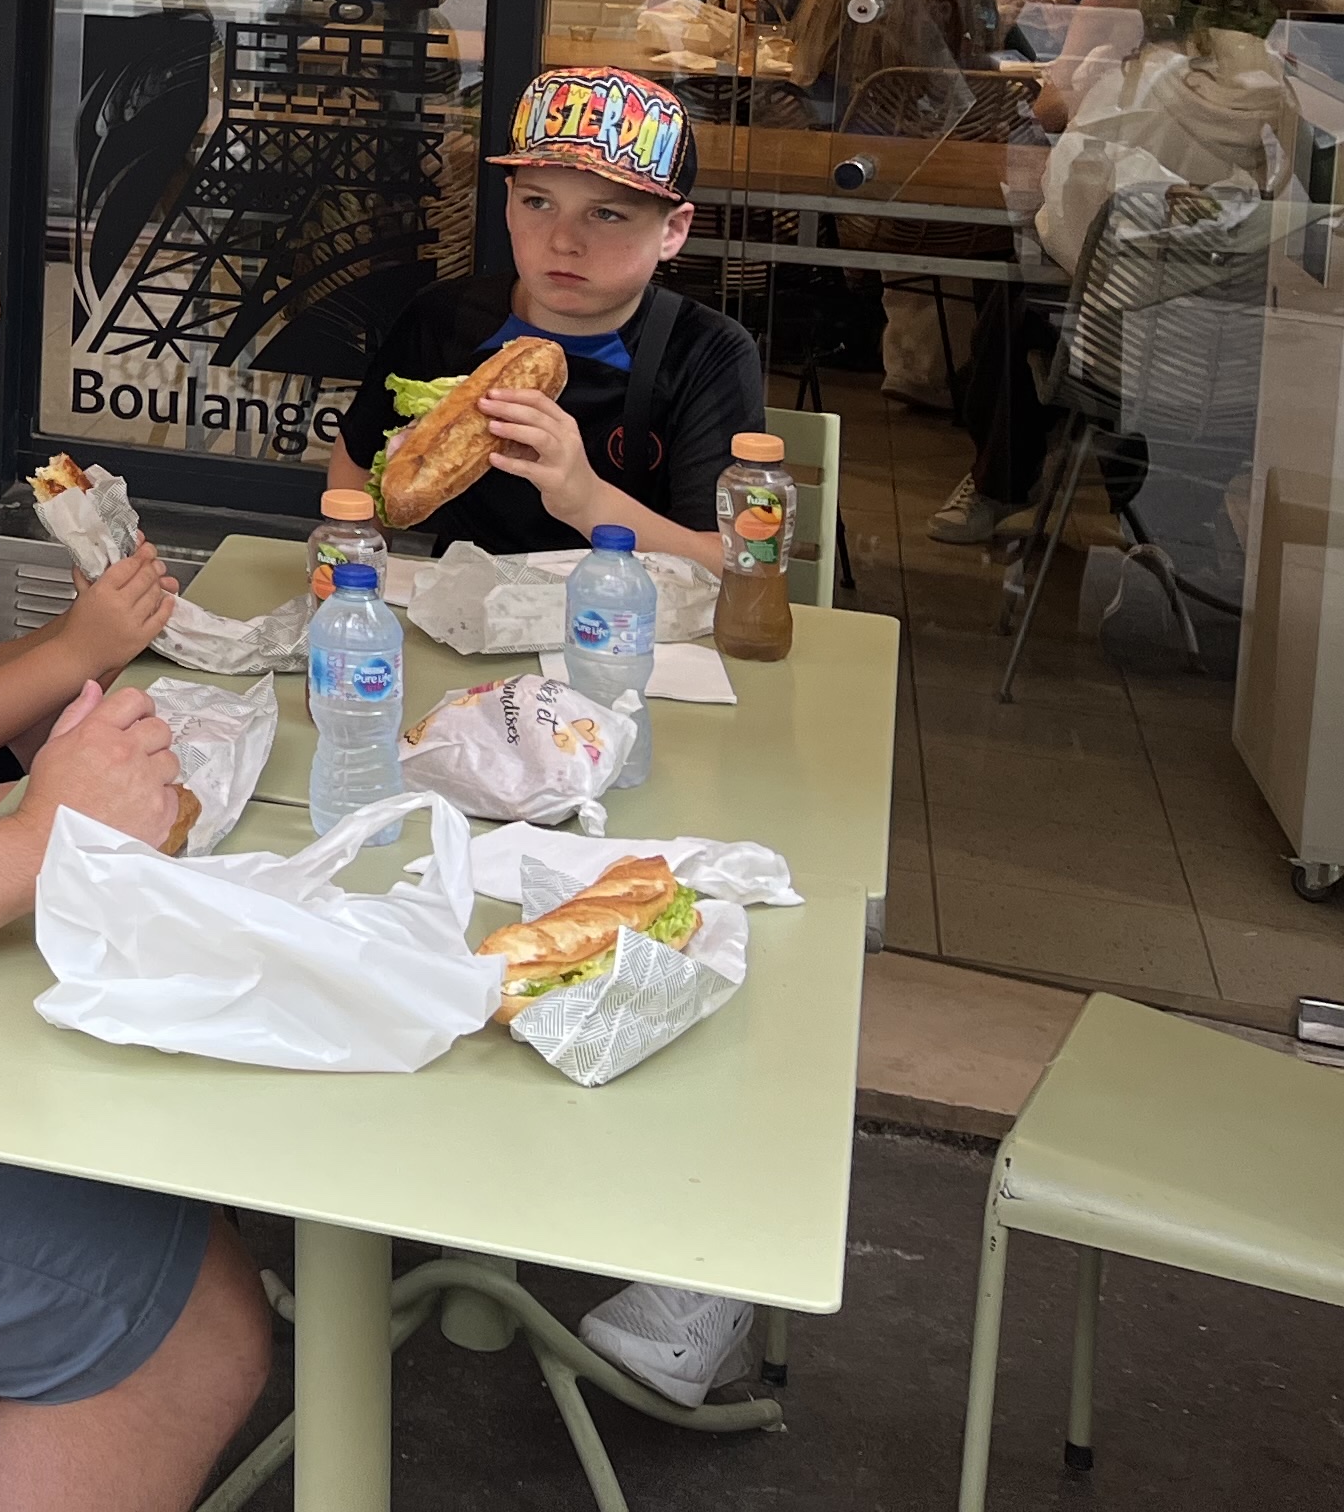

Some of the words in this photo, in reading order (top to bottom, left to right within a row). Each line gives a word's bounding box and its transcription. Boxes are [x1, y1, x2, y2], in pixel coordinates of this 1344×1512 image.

[512, 81, 684, 178] AMSTERDAM
[71, 368, 344, 455] Boulange
[354, 673, 377, 684] Pure
[499, 680, 520, 746] andises
